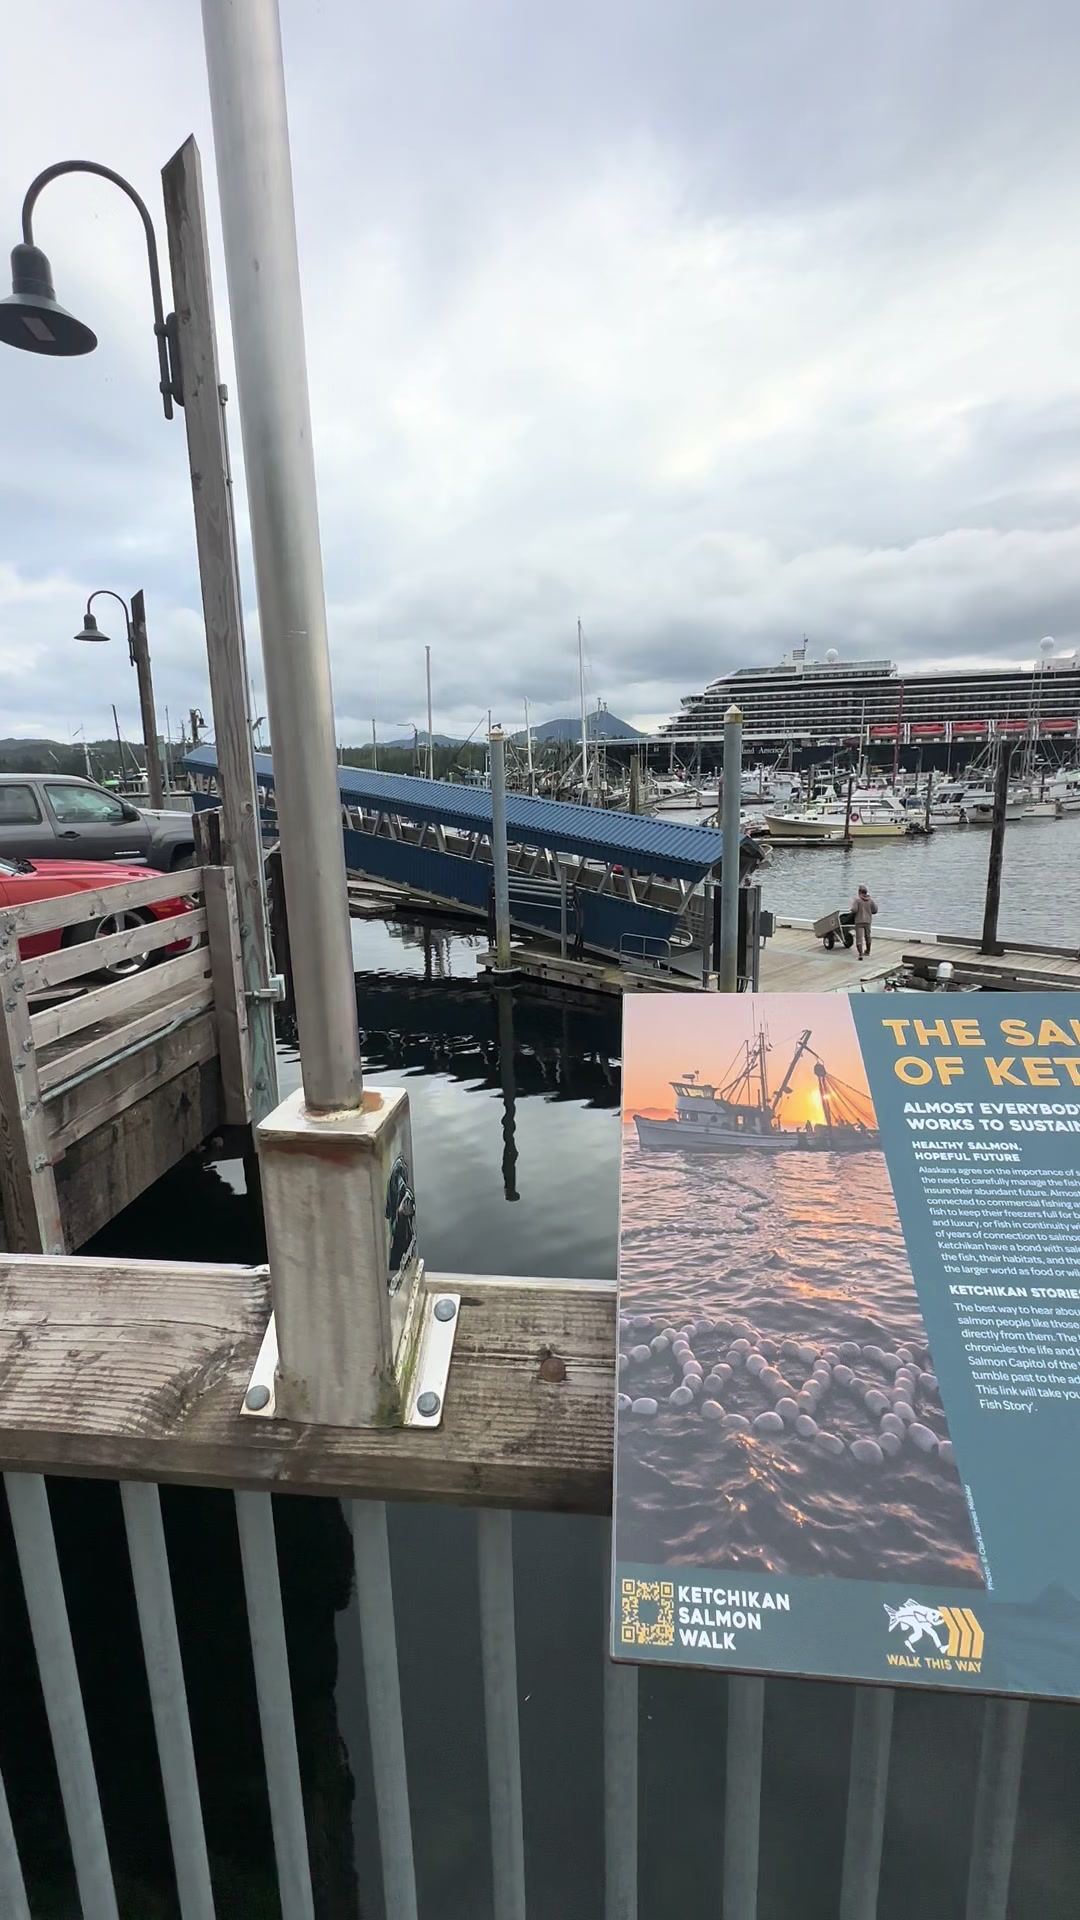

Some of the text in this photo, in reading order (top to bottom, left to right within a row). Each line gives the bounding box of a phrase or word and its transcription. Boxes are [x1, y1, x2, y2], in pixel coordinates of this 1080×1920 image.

[882, 1019, 986, 1046] THE
[894, 1056, 1080, 1086] OF KET
[903, 1102, 1080, 1115] ALMOST EVERYBOD
[906, 1118, 975, 1131] WORKS
[979, 1119, 1005, 1132] TO
[912, 1141, 1023, 1151] HEALTHY SALMON,
[915, 1152, 1021, 1162] HOPEFUL FUTURE
[919, 1166, 957, 1174] Alaskans
[995, 1167, 1010, 1175] the
[1011, 1168, 1064, 1176] importance
[921, 1176, 936, 1184] the
[972, 1178, 1009, 1187] carefully
[952, 1187, 973, 1195] their
[974, 1188, 1018, 1196] abundant
[1018, 1189, 1049, 1197] future.
[927, 1198, 975, 1206] connected
[976, 1198, 986, 1206] to
[987, 1199, 1040, 1207] commercial
[1041, 1199, 1073, 1209] fishing
[958, 1208, 981, 1218] keep
[981, 1209, 1003, 1217] their
[1004, 1209, 1042, 1217] freezers
[1042, 1210, 1058, 1218] full
[1058, 1210, 1072, 1219] for
[950, 1219, 982, 1229] luxury,
[994, 1220, 1011, 1228] fish
[1022, 1221, 1070, 1231] continuity
[946, 1231, 972, 1239] years
[983, 1232, 1036, 1240] connection
[1048, 1233, 1080, 1241] salmo
[938, 1241, 984, 1250] Ketchikan
[985, 1242, 1009, 1251] have
[1016, 1243, 1042, 1252] bond
[1042, 1244, 1064, 1252] with
[941, 1252, 957, 1261] the
[958, 1253, 979, 1262] fish,
[979, 1254, 1002, 1262] their
[1002, 1254, 1045, 1264] habitats,
[1046, 1256, 1065, 1265] and
[944, 1264, 960, 1273] the
[961, 1265, 989, 1275] larger
[990, 1266, 1017, 1275] world
[1030, 1266, 1054, 1276] food
[1055, 1269, 1065, 1277] or
[949, 1285, 1080, 1299] KETCHIKAN STORIE
[954, 1302, 973, 1312] The
[974, 1303, 997, 1313] best
[998, 1306, 1017, 1315] way
[1018, 1307, 1030, 1315] to
[1030, 1305, 1053, 1315] hear
[957, 1316, 1079, 1329] salmon people like those
[961, 1329, 999, 1340] directly
[1000, 1330, 1025, 1340] from
[1025, 1331, 1056, 1341] them.
[1056, 1332, 1077, 1342] The
[965, 1343, 1017, 1353] chronicles
[1018, 1344, 1036, 1354] the
[1036, 1345, 1053, 1355] life
[1054, 1347, 1075, 1356] and
[968, 1356, 1007, 1367] Salmon
[1008, 1358, 1046, 1370] Capitol
[1047, 1359, 1058, 1369] of
[1059, 1360, 1078, 1370] the
[972, 1370, 1009, 1381] tumble
[1011, 1373, 1035, 1383] past
[1035, 1373, 1047, 1383] to
[1047, 1373, 1067, 1384] the
[975, 1384, 998, 1395] This
[999, 1386, 1019, 1396] link
[1019, 1386, 1037, 1397] will
[1037, 1388, 1062, 1398] take
[980, 1399, 1002, 1410] Fish
[678, 1585, 790, 1611] KETCHIKAN
[678, 1607, 762, 1630] SALMON
[679, 1629, 737, 1650] WALK
[887, 1654, 981, 1673] WALK THIS WAY
